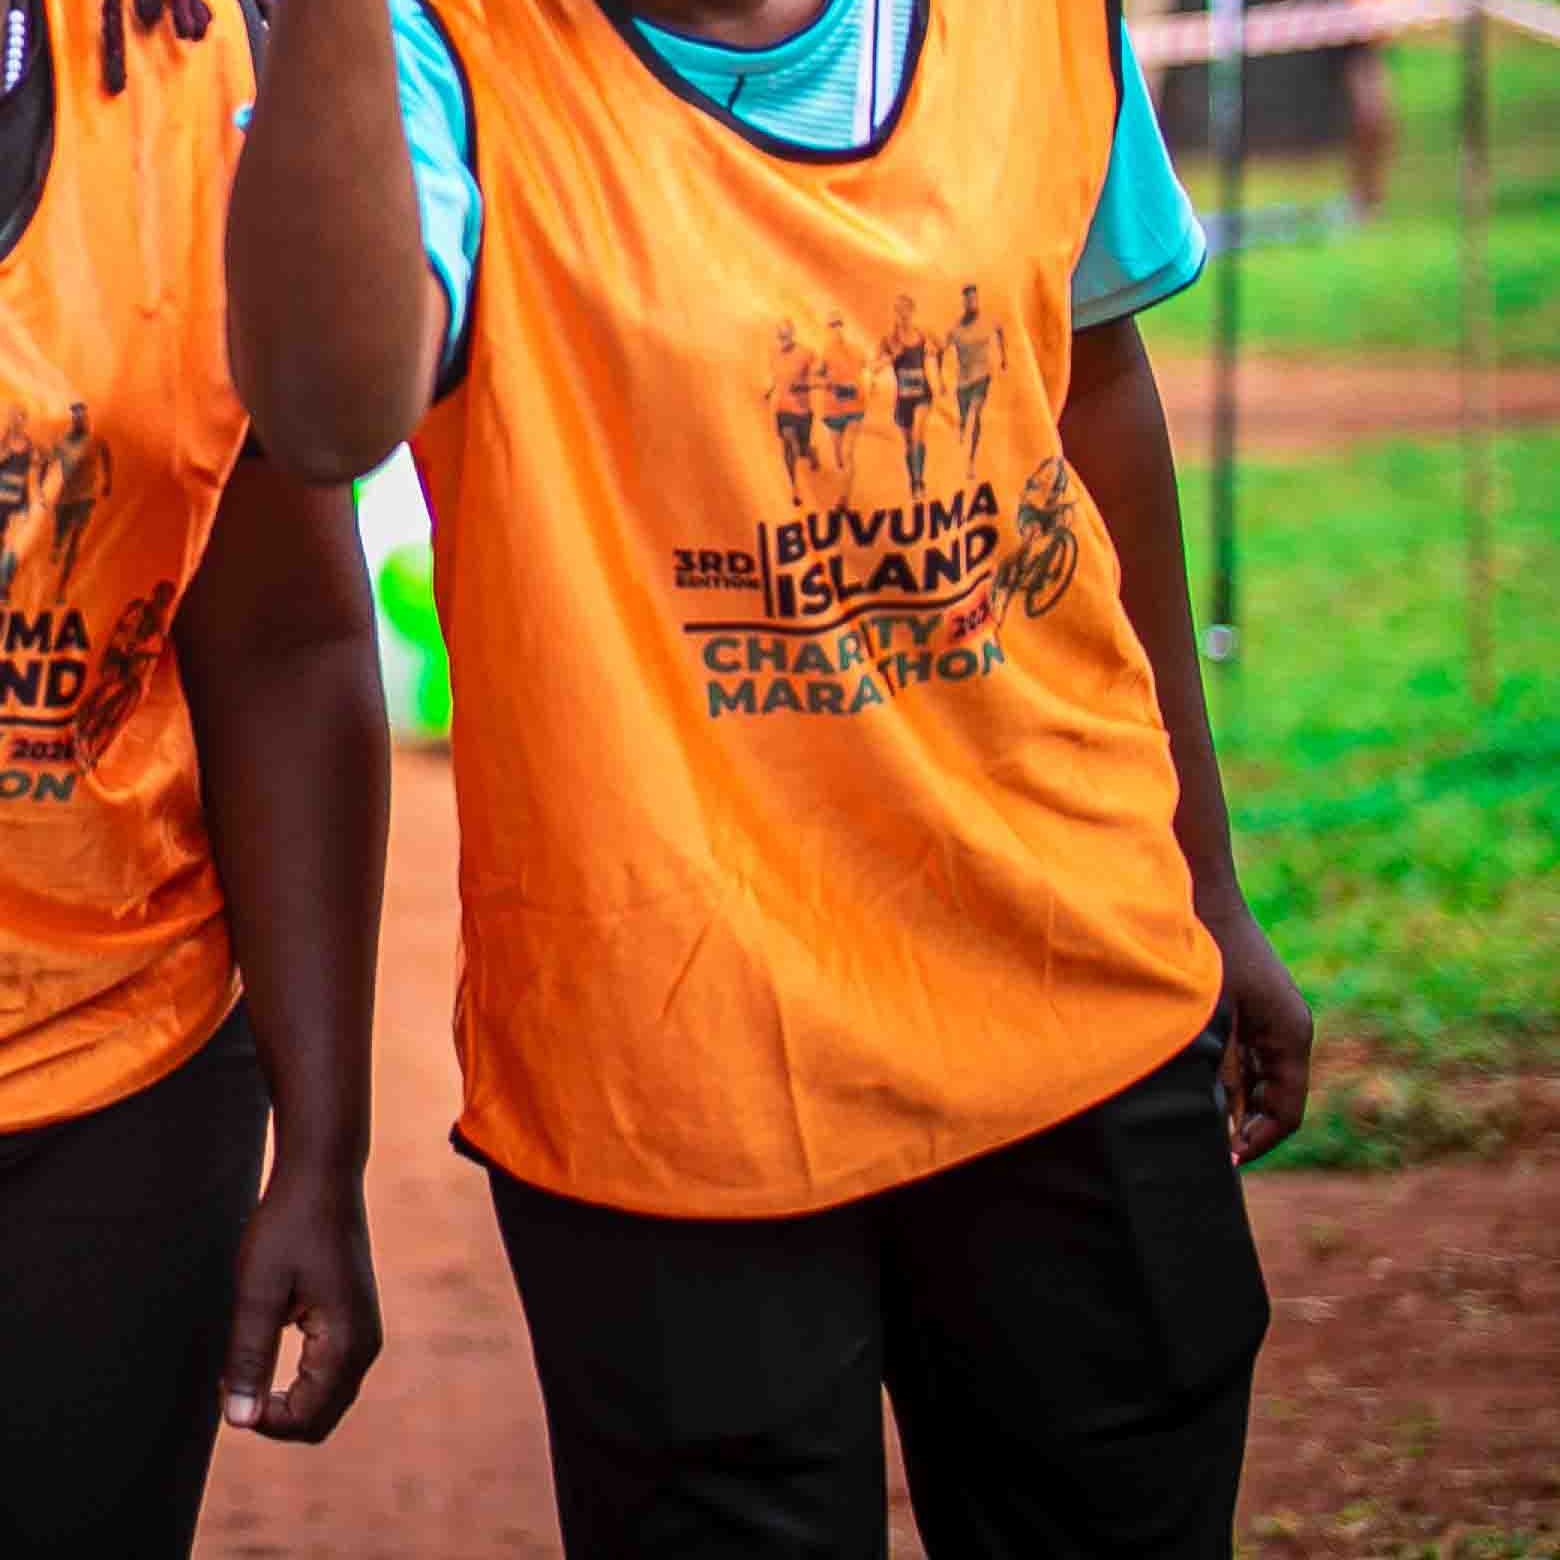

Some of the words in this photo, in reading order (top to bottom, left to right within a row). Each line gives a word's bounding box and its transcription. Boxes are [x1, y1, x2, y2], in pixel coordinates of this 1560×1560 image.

[672, 548, 755, 576] 3RD
[776, 483, 1000, 565] BUVUMA
[778, 525, 1000, 619] ISLAND
[702, 614, 943, 676] CHARITY
[707, 641, 1006, 719] MARATHON
